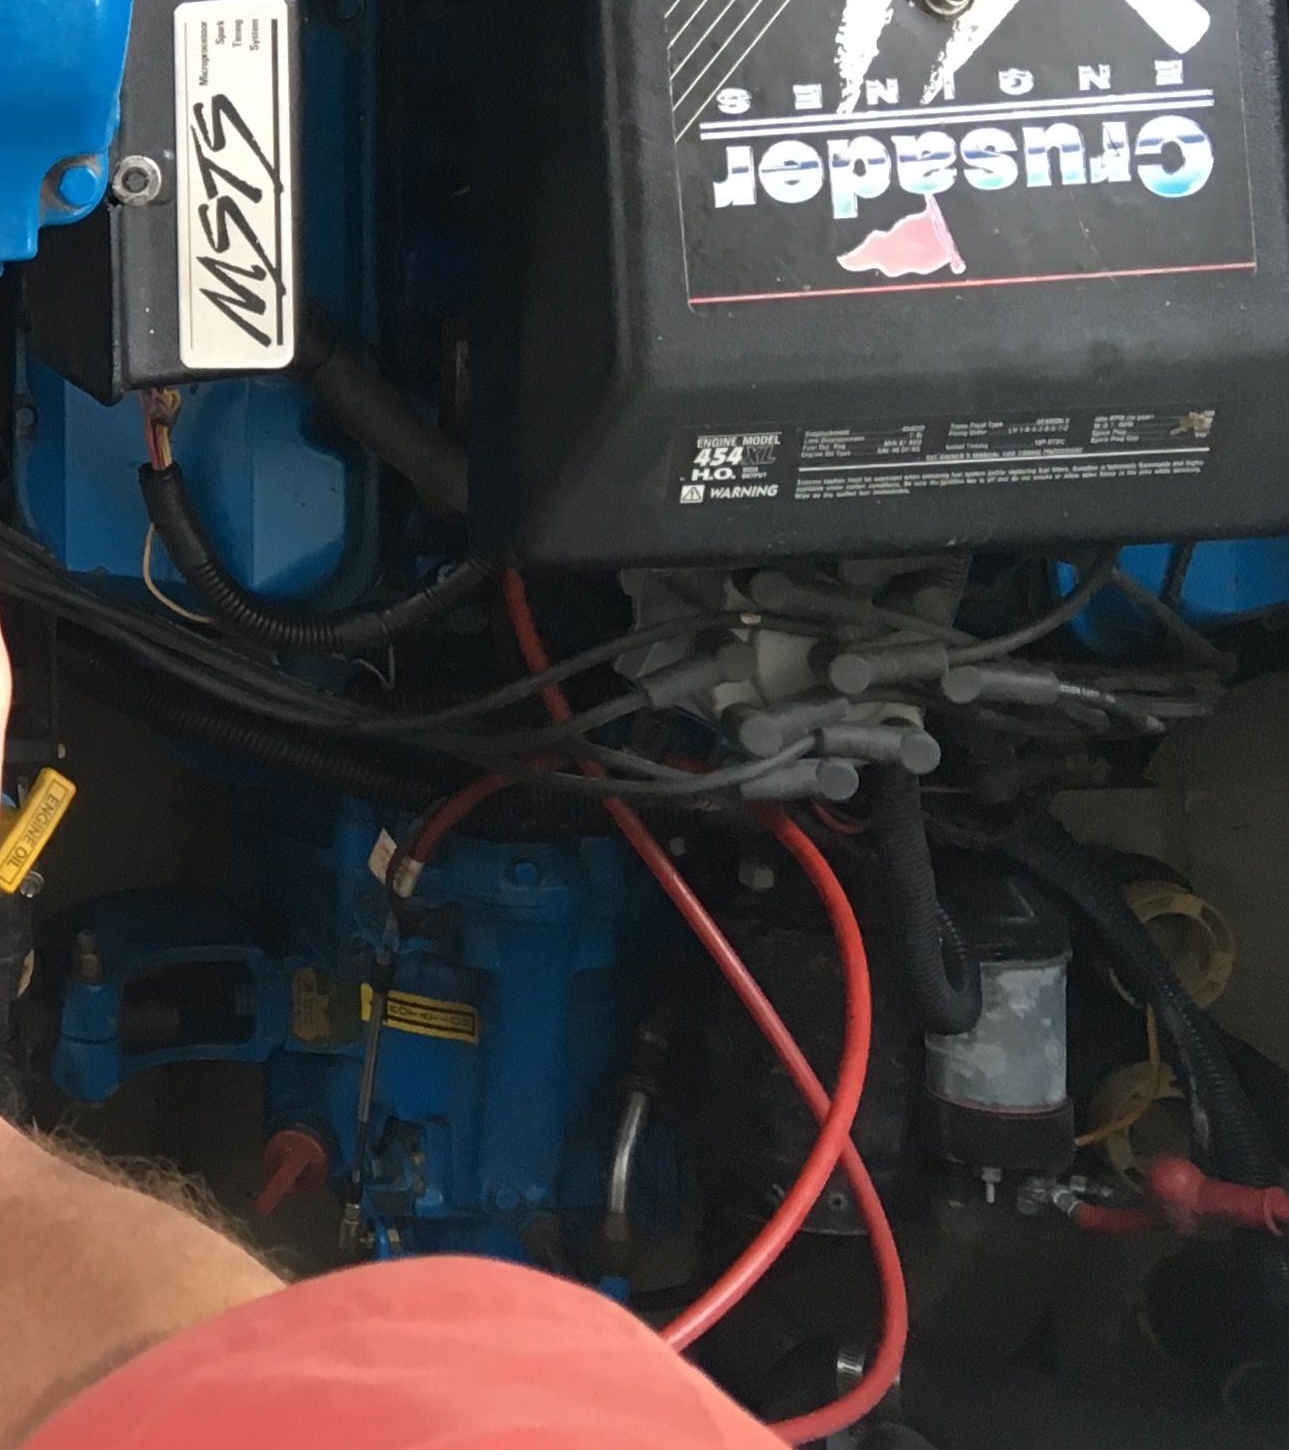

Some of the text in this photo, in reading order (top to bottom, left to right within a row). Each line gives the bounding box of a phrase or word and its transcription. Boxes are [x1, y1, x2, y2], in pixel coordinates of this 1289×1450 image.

[214, 20, 227, 45] Spark
[231, 19, 244, 48] Timing
[249, 18, 261, 51] System
[198, 21, 210, 86] Microprocessor
[717, 60, 1183, 114] ENGINES
[714, 116, 1214, 219] Crusader
[190, 94, 284, 347] MSTS
[693, 445, 777, 467] 454XL
[697, 435, 781, 448] ENGINE MODEL
[691, 467, 736, 481] H.O.
[710, 484, 779, 499] WARNING
[7, 793, 59, 868] ENGINE OIL
